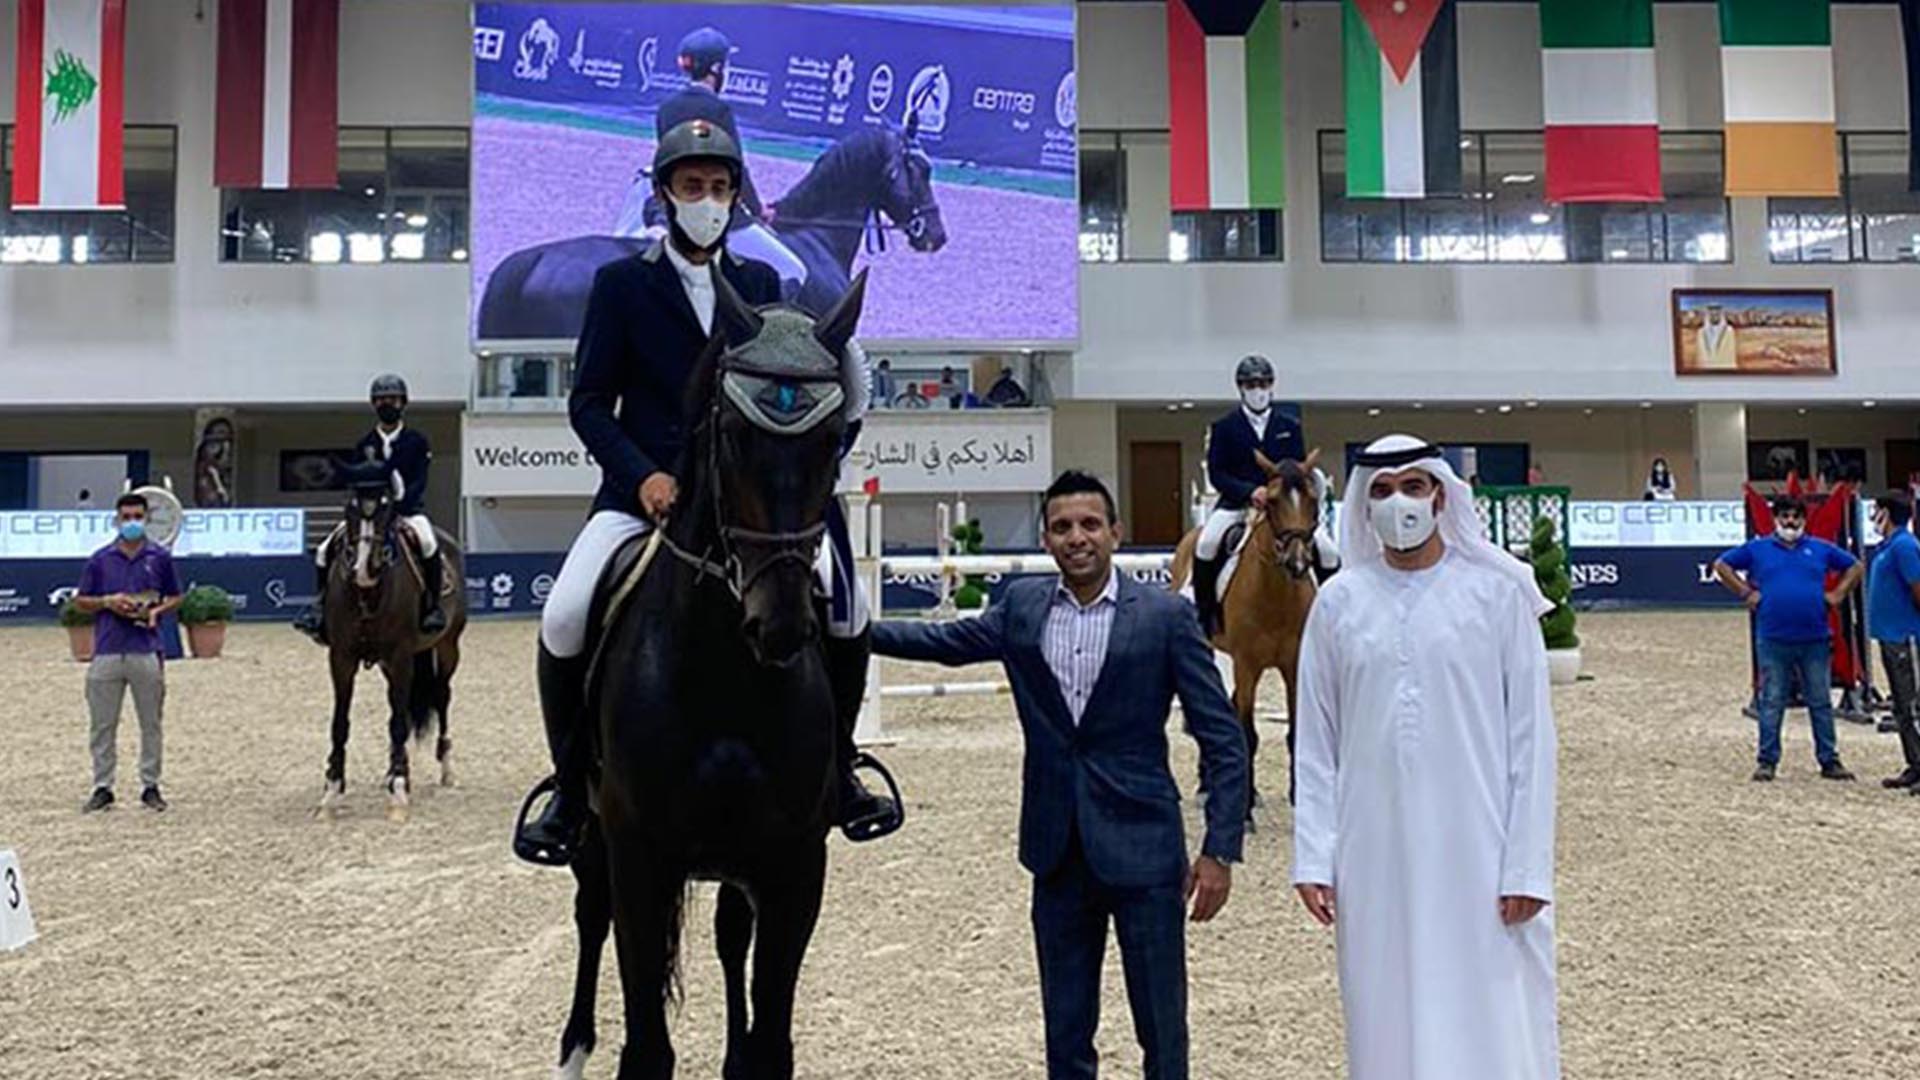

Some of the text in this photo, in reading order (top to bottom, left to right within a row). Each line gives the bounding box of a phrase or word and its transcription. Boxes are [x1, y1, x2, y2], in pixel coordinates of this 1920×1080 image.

[475, 446, 579, 467] Welcome
[921, 440, 942, 475] في
[948, 440, 988, 475] بكم
[993, 435, 1034, 463] أهلا
[5, 866, 20, 910] 3
